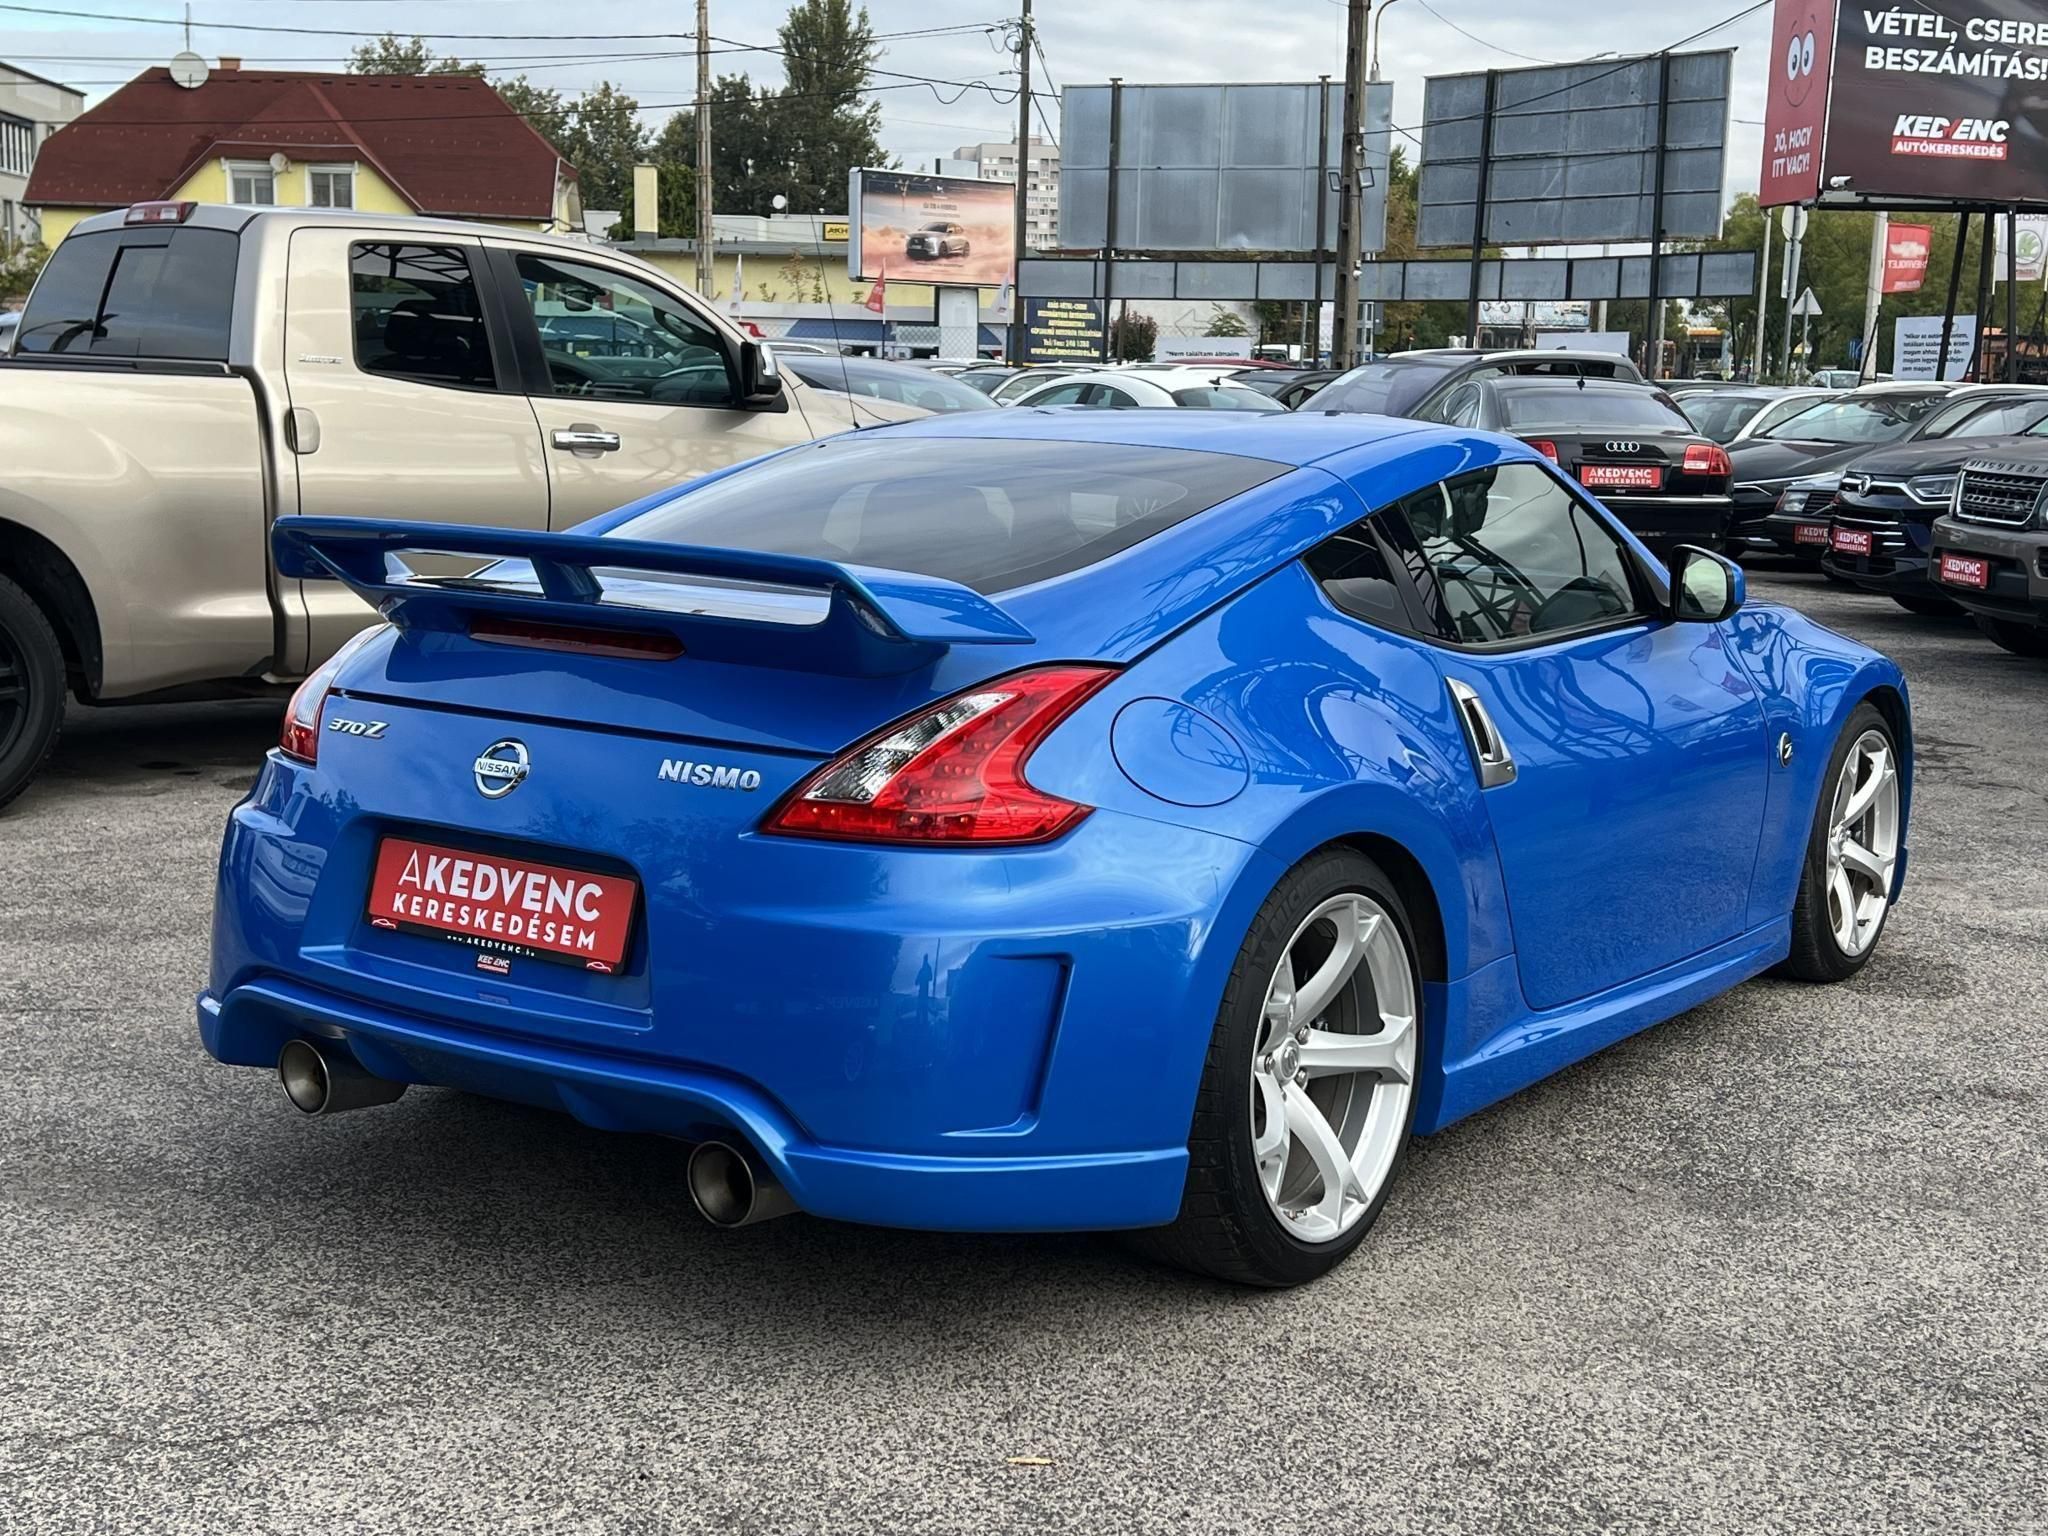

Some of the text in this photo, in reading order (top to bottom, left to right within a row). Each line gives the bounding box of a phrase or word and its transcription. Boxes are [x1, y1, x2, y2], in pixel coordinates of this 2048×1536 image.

[1864, 7, 1957, 43] VÉTEL,
[1865, 45, 2048, 80] BESZÁMÍTÁS!
[1774, 125, 1813, 154] JÓ, HOGY
[1895, 140, 2004, 157] AUTÓKERESKEDÉS
[1772, 152, 1810, 178] ITT VAGY!
[1799, 526, 1828, 537] AKEDVE
[328, 717, 390, 740] 370Z
[477, 760, 521, 776] NISSAN
[658, 758, 762, 792] NISMO
[392, 892, 596, 951] KERESKEDÉSEM
